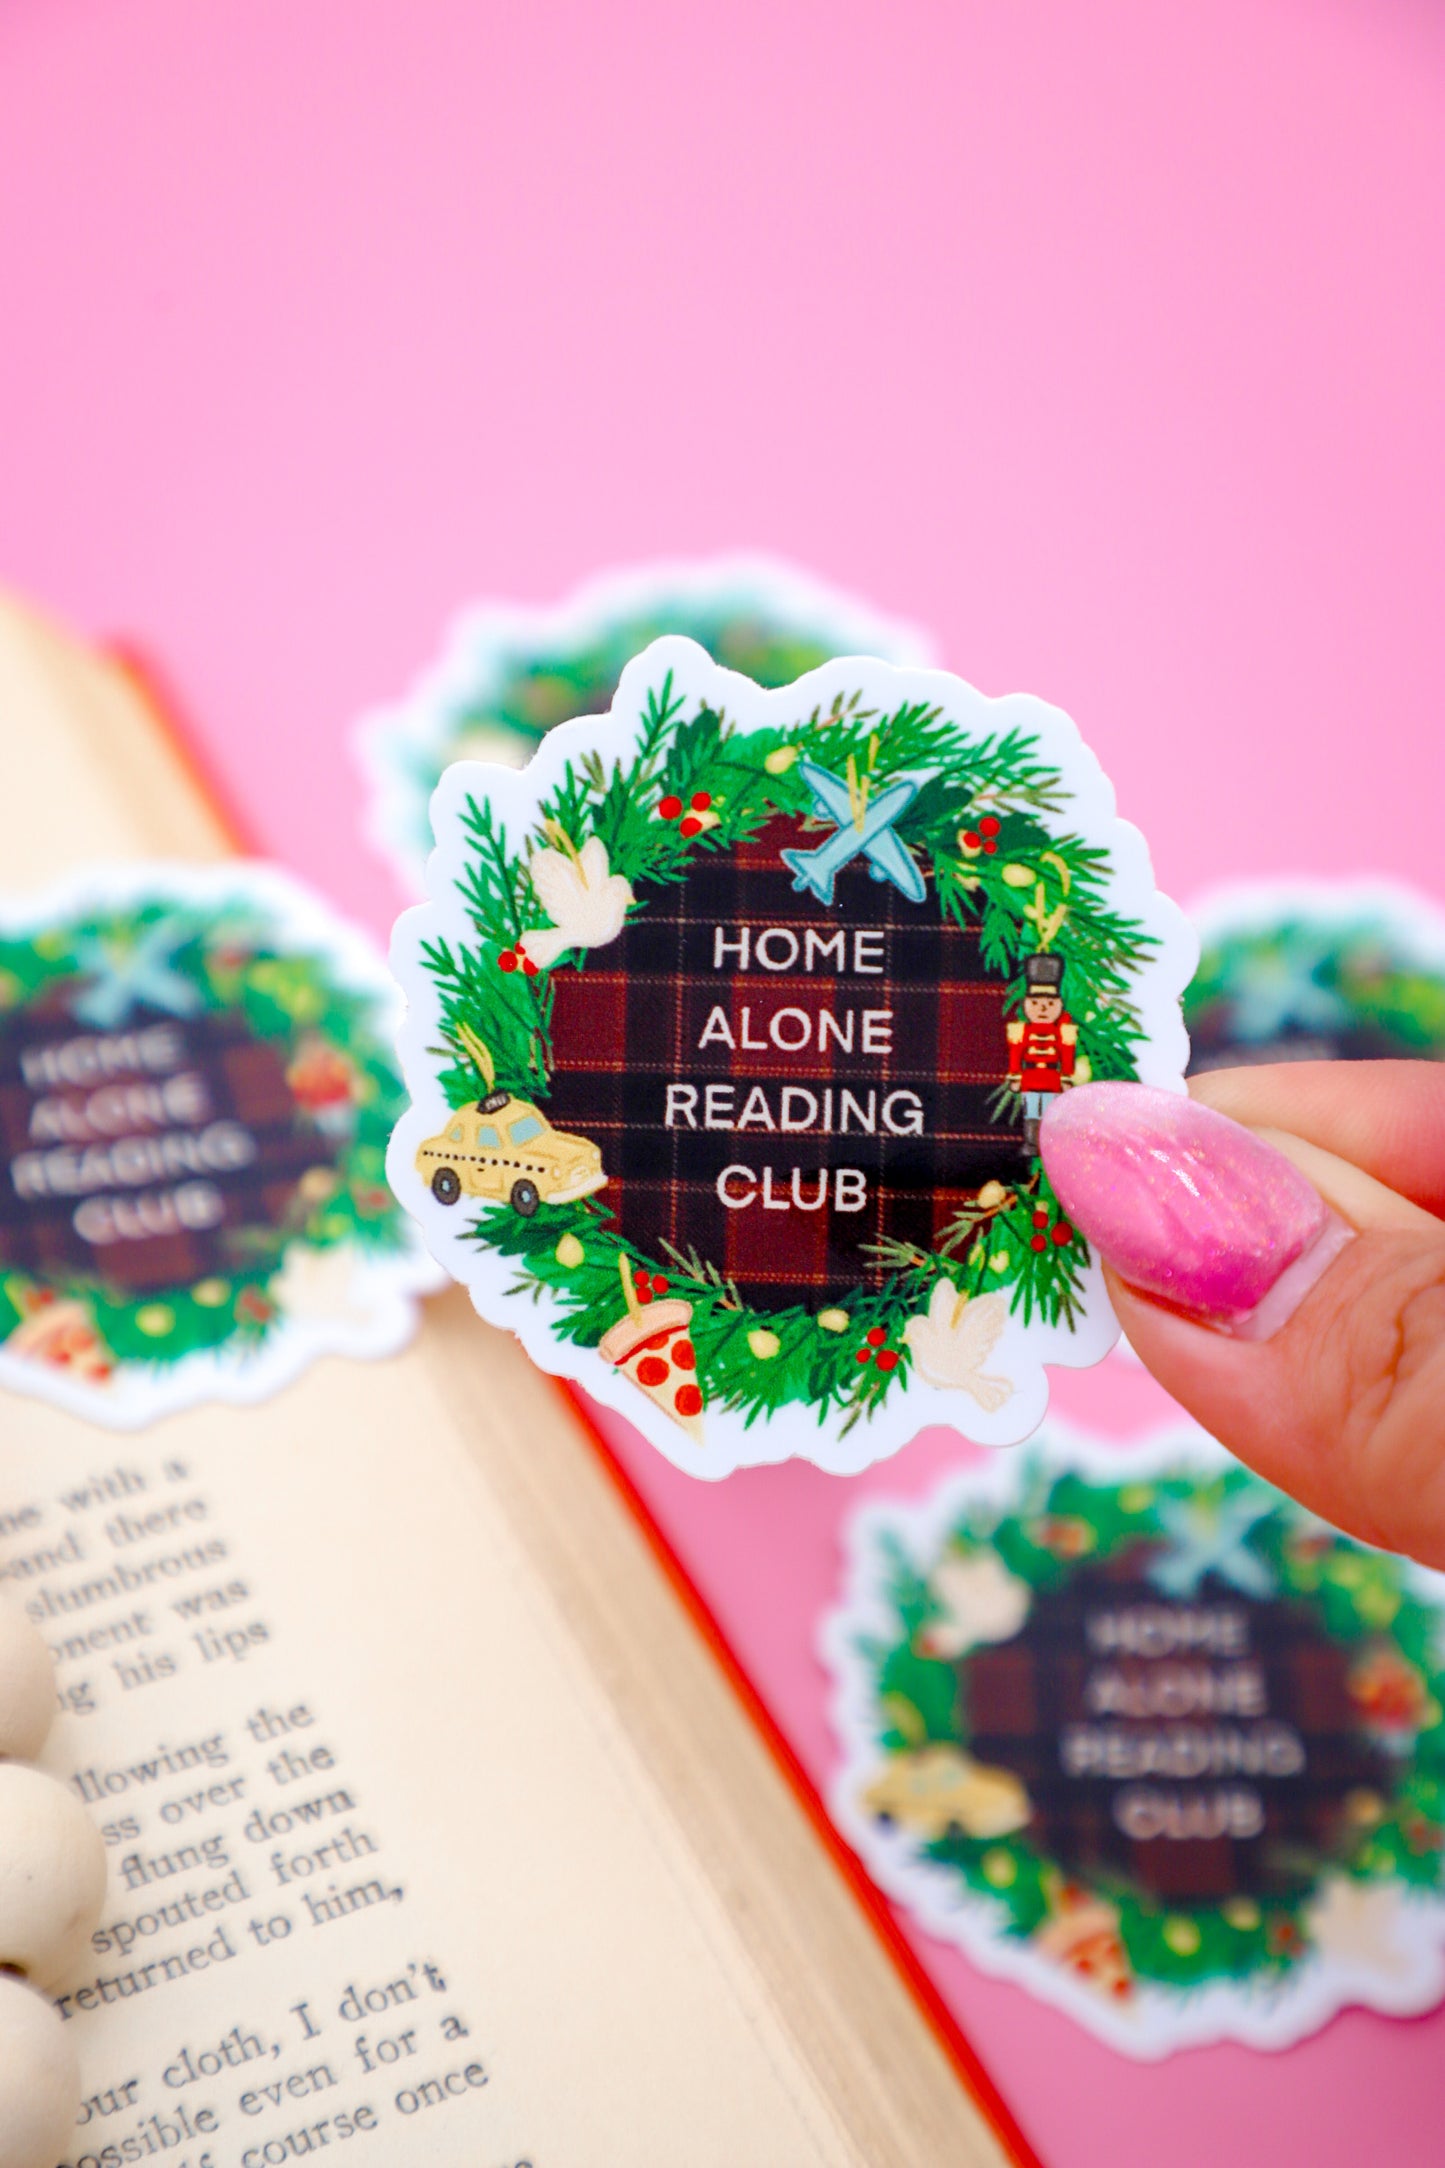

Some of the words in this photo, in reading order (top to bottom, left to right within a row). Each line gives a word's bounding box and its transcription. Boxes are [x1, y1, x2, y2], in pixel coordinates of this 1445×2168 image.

[713, 926, 884, 974] HOME
[697, 1005, 893, 1054] ALONE
[664, 1083, 924, 1136] READING
[10, 1121, 255, 1199] READING
[716, 1164, 867, 1213] CLUB
[72, 1181, 223, 1245] CLUB
[60, 1466, 147, 1514] with
[162, 1459, 190, 1482] a
[104, 1497, 208, 1547] there
[25, 1538, 228, 1624] slumbrous
[171, 1578, 249, 1621] was
[111, 1651, 177, 1690] his
[192, 1619, 270, 1662] lips
[72, 1733, 230, 1804] llowing
[247, 1703, 315, 1744] the
[159, 1775, 246, 1825] over
[266, 1745, 336, 1786] the
[119, 1834, 231, 1892] flung
[243, 1788, 357, 1843] down
[91, 1869, 251, 1957] spouted
[270, 1827, 380, 1886] forth
[53, 1926, 237, 2021] returned
[248, 1914, 293, 1946] to
[302, 1879, 406, 1926] him,
[162, 2027, 281, 2089] cloth,
[289, 2001, 321, 2041] I
[338, 1961, 448, 2022] don't
[56, 2104, 219, 2168] ossible
[238, 2063, 339, 2117] even
[354, 2029, 418, 2074] for
[439, 2013, 470, 2042] a
[241, 2105, 378, 2168] course
[395, 2062, 489, 2115] once
